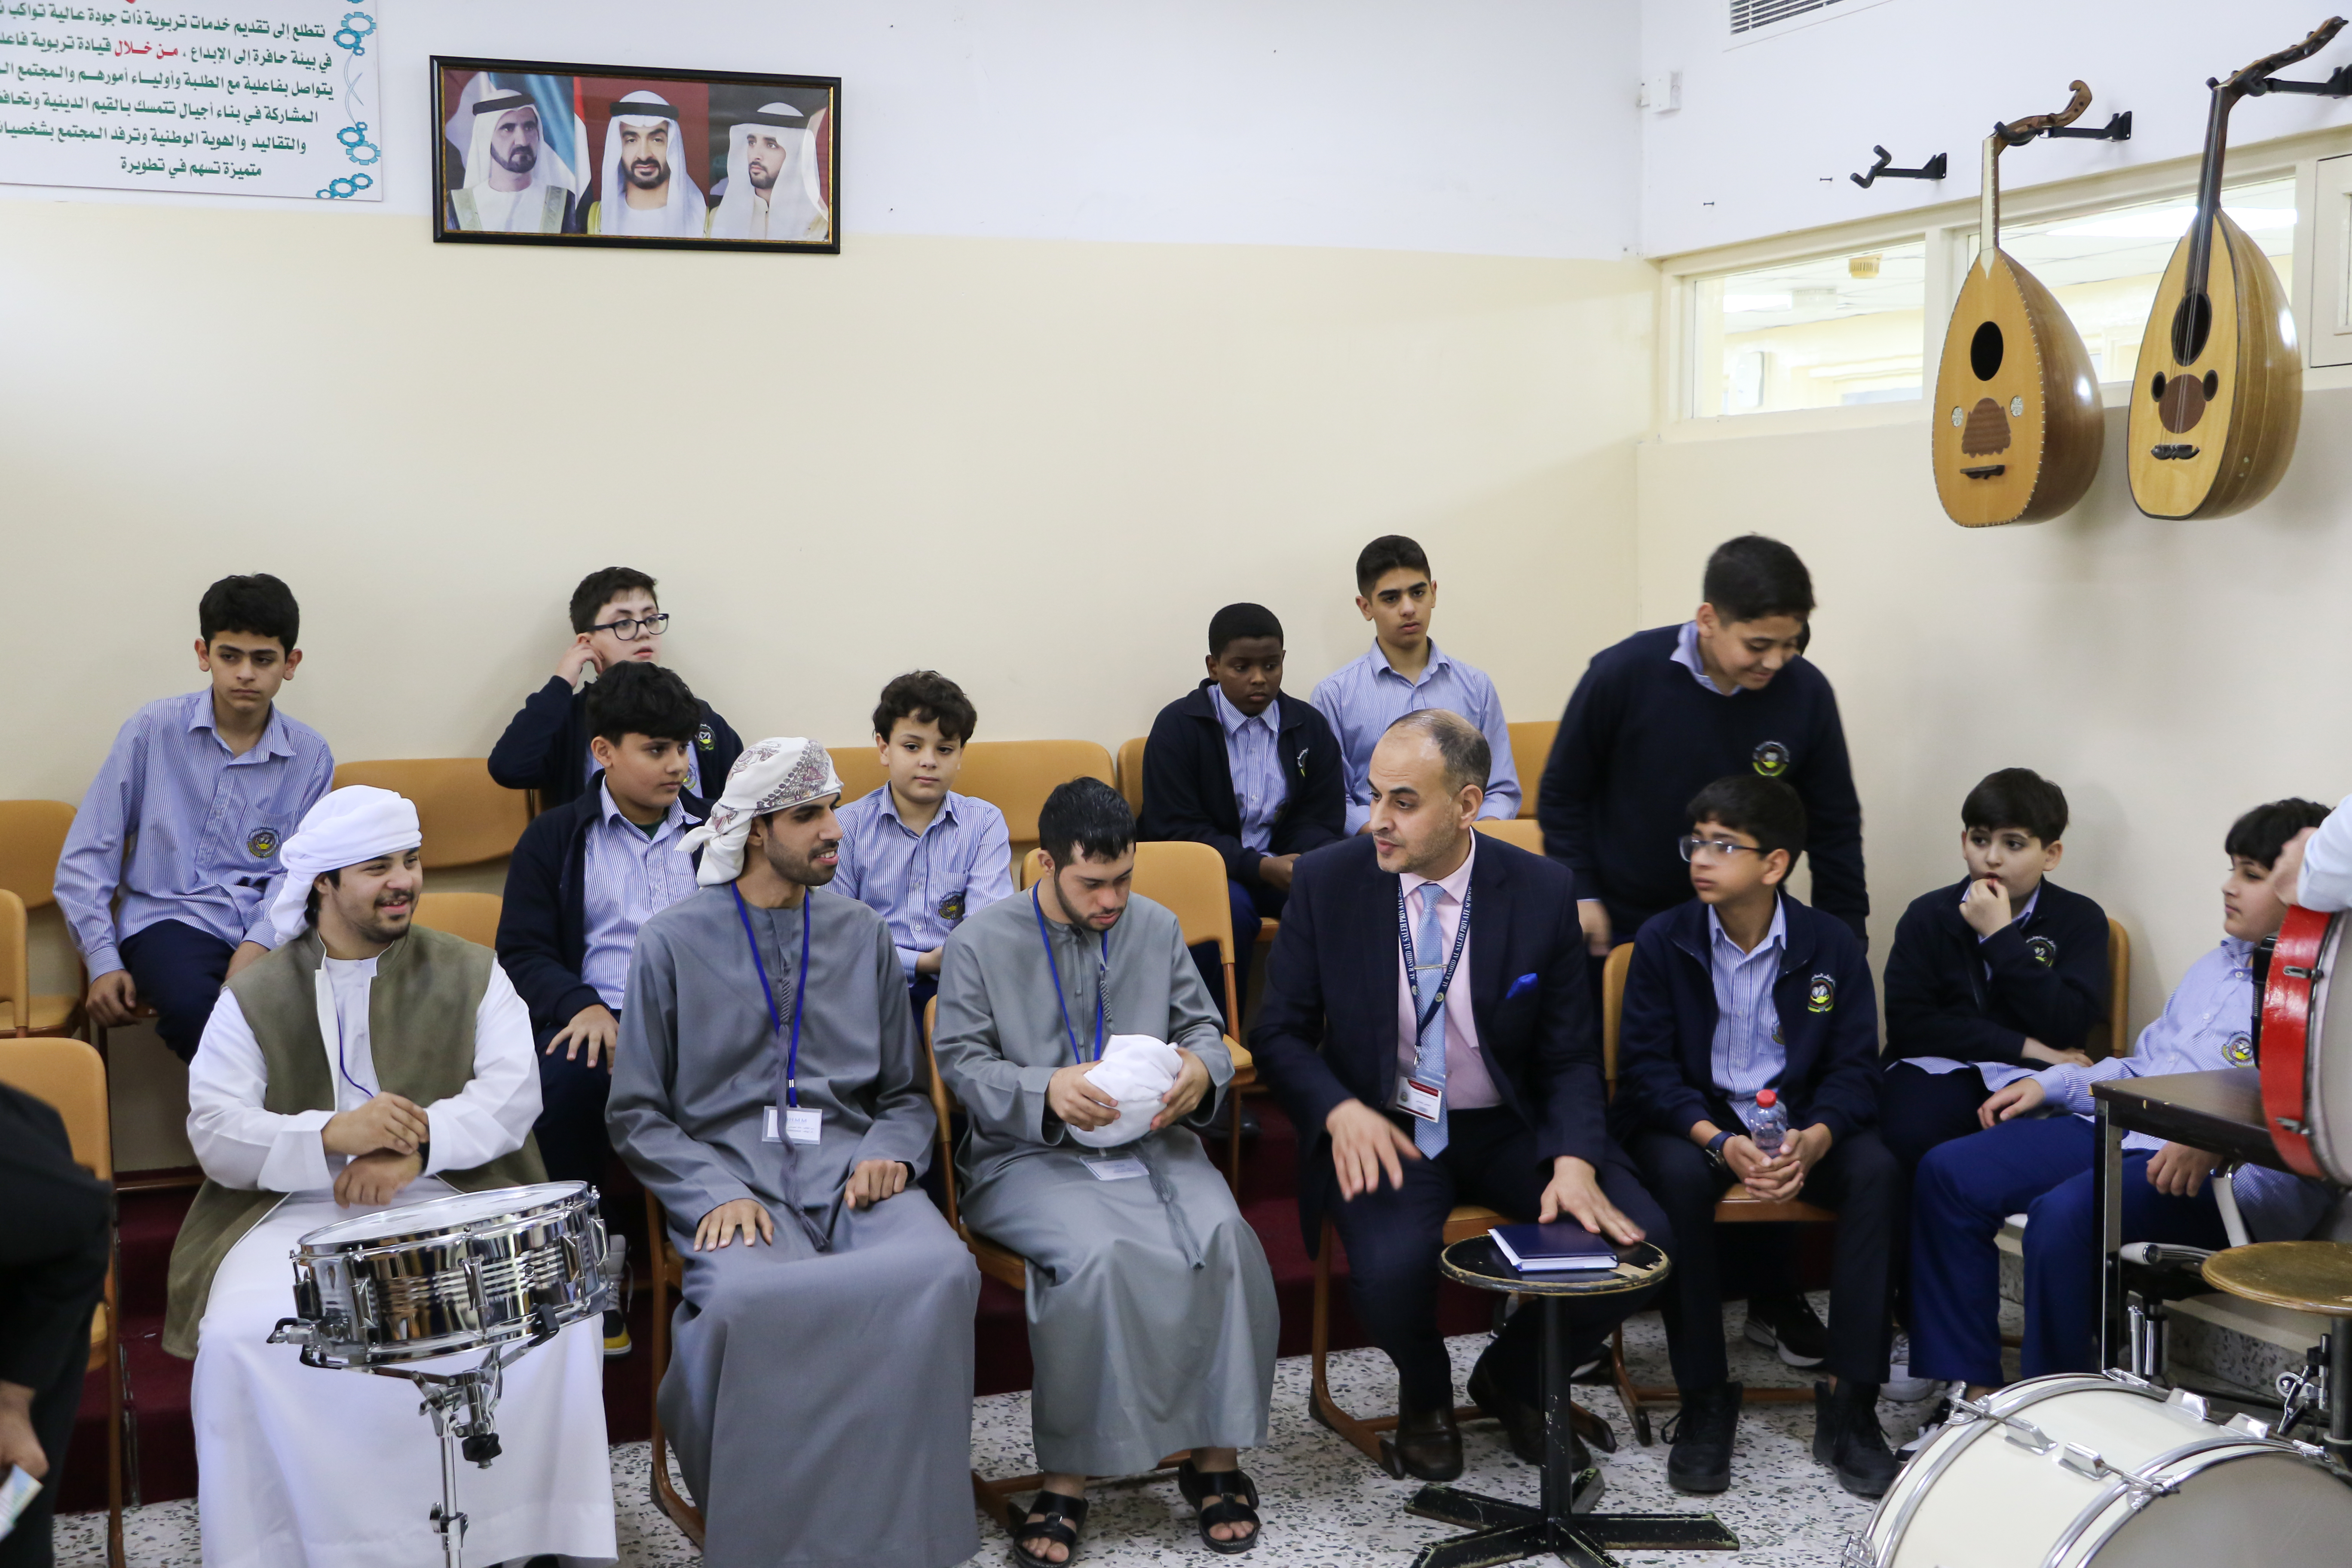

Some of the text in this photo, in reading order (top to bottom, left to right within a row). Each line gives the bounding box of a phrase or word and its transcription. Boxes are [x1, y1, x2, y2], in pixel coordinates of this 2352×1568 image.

[9, 3, 46, 21] تواكب
[48, 3, 86, 24] عالية
[87, 7, 117, 27] جودة
[121, 9, 143, 25] ذات
[144, 10, 187, 32] تربوية
[190, 15, 231, 31] خدمات
[234, 19, 270, 38] تقديم
[273, 22, 290, 40] إلى
[292, 23, 326, 42] نتطلع
[0, 31, 29, 46] فاعل
[31, 32, 75, 54] تربوية
[77, 37, 112, 56] قيادة
[114, 40, 153, 57] خلال
[156, 43, 178, 60] من
[233, 49, 251, 66] إلى
[290, 50, 316, 71] بيئة
[17, 63, 75, 83] والمجتمع
[318, 52, 332, 74] في
[78, 67, 128, 86] أمورهم
[131, 70, 181, 90] وأولياء
[183, 71, 224, 91] الطلبة
[242, 75, 288, 98] بفاعلية
[227, 80, 241, 95] مع
[291, 81, 334, 101] يتواصل
[42, 92, 89, 113] الدينية
[92, 96, 132, 117] بالقيم
[134, 100, 176, 115] تتمسك
[179, 101, 214, 120] أجيال
[217, 104, 241, 124] بناء
[243, 105, 262, 126] في
[263, 105, 318, 124] المشاركة
[0, 120, 306, 155] والتقاليد والهوية الوطنية وترفد المجتمع بشخصيا
[120, 156, 262, 180] متميزة تسهم في تطويرة
[1460, 907, 1470, 933] PRIVATE
[1400, 923, 1410, 942] SALEH
[1455, 932, 1465, 952] SALEH
[1403, 942, 1412, 950] AL
[1453, 952, 1460, 960] AL
[1405, 950, 1415, 972] RASHID
[1445, 959, 1457, 980] RASHID
[1409, 972, 1415, 980] AL
